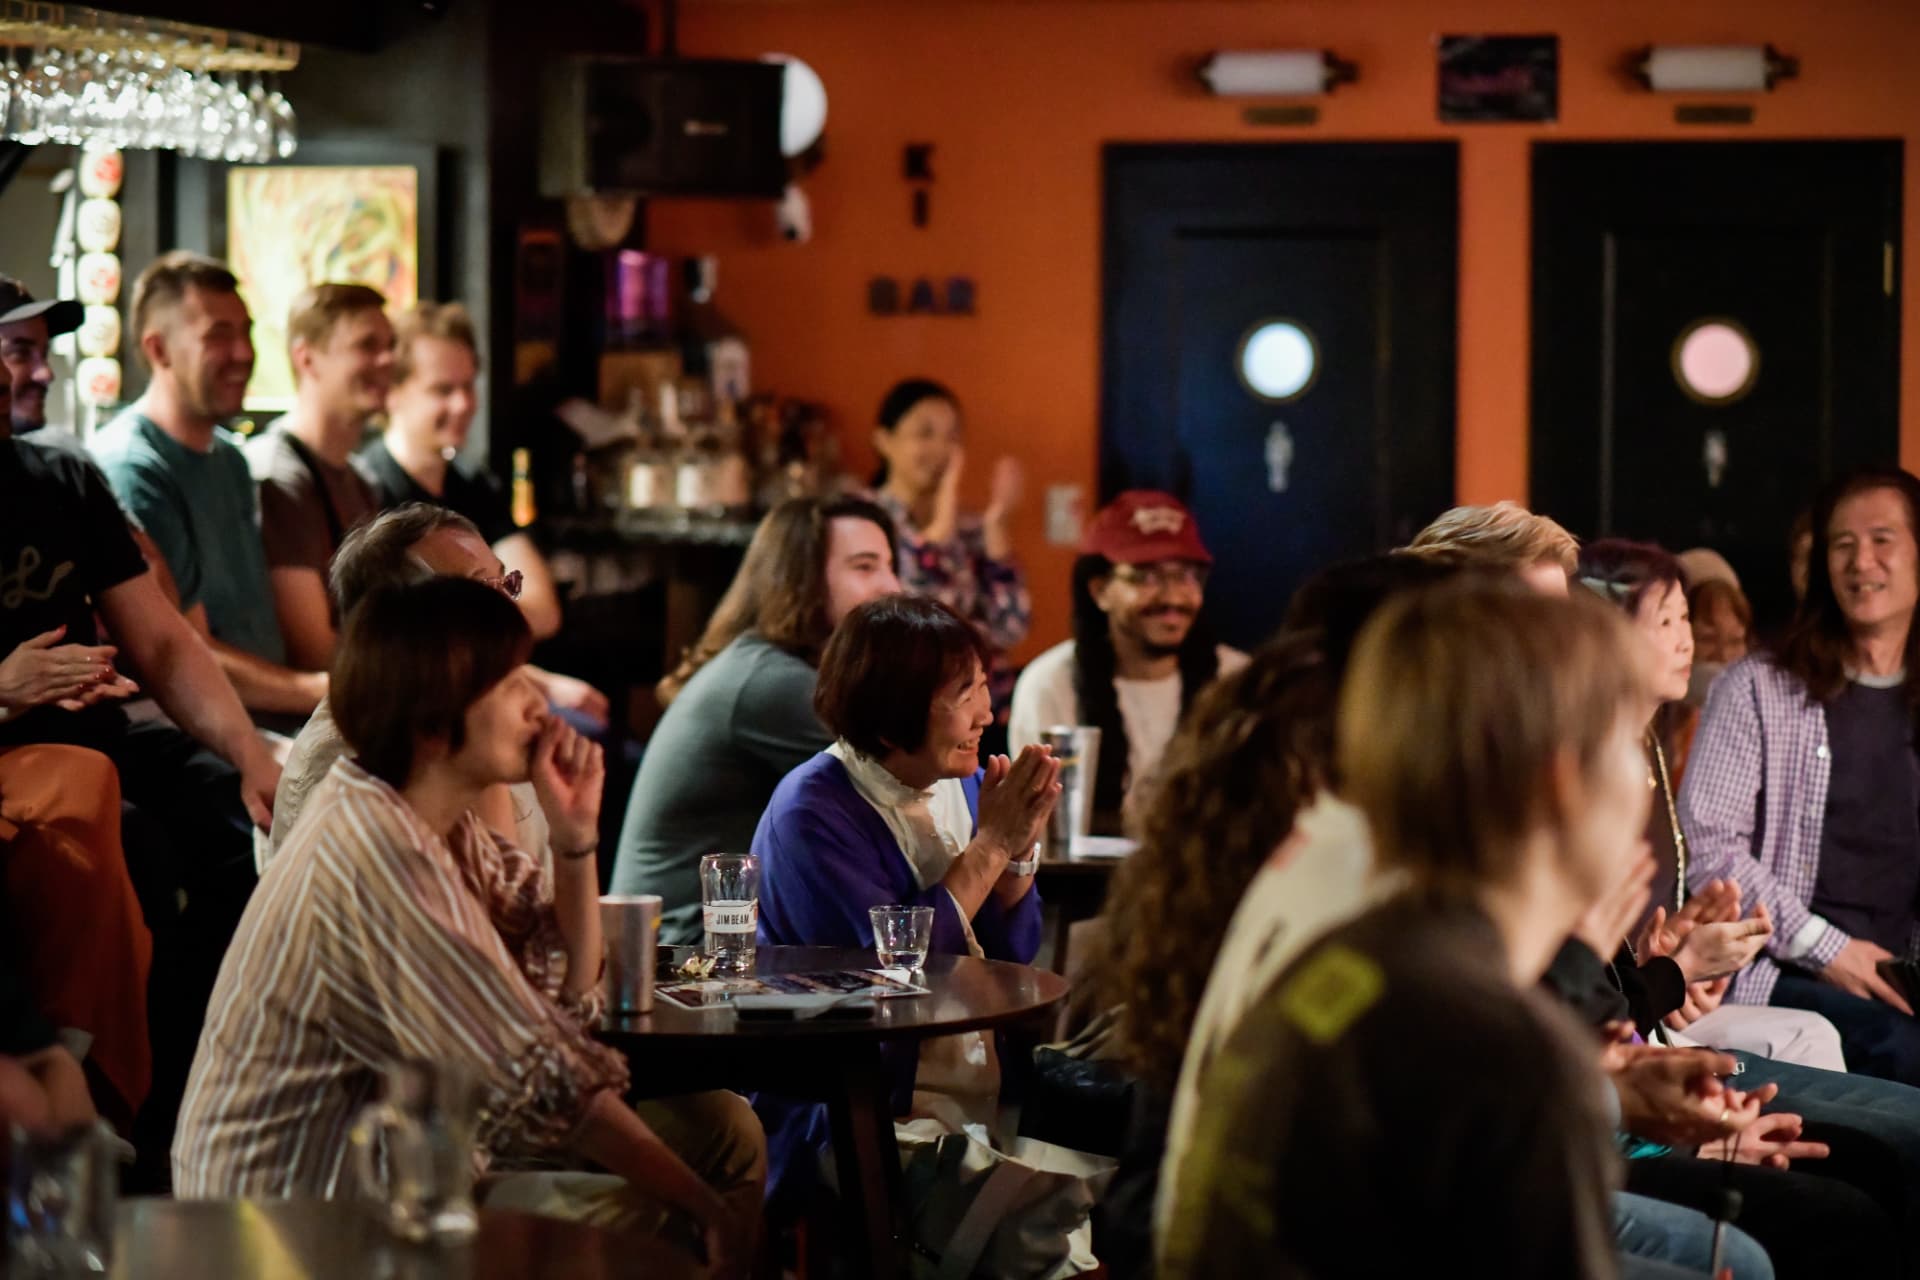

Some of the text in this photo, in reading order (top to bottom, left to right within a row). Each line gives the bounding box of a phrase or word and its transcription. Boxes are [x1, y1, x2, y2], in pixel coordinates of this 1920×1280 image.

[868, 275, 978, 318] BAR
[716, 914, 730, 925] JIM
[731, 913, 750, 925] BEAM
